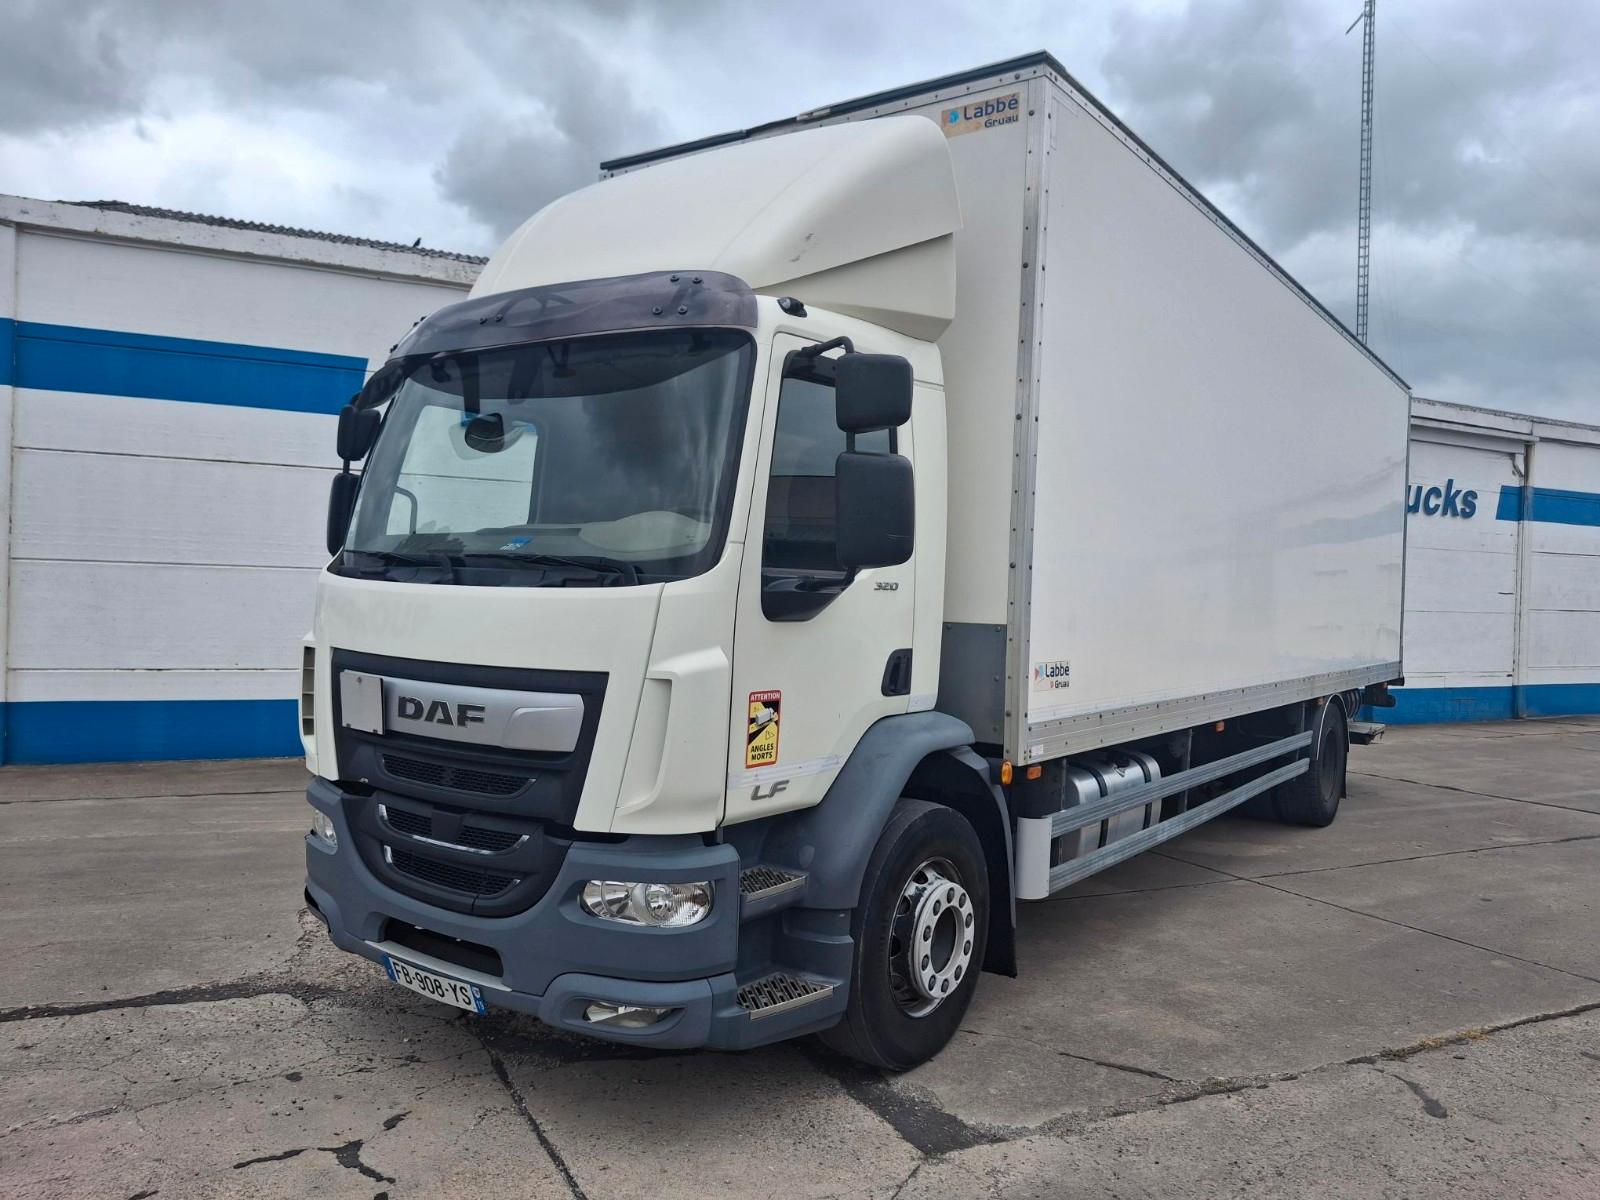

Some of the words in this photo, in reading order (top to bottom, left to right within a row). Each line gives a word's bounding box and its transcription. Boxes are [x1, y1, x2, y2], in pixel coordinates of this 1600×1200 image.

[984, 115, 1019, 128] Gruau
[873, 581, 900, 591] 320
[750, 692, 780, 701] ATTENTION
[397, 695, 485, 728] DAF
[750, 743, 774, 753] ANGLES
[751, 751, 773, 761] MORTS
[750, 779, 790, 801] LF
